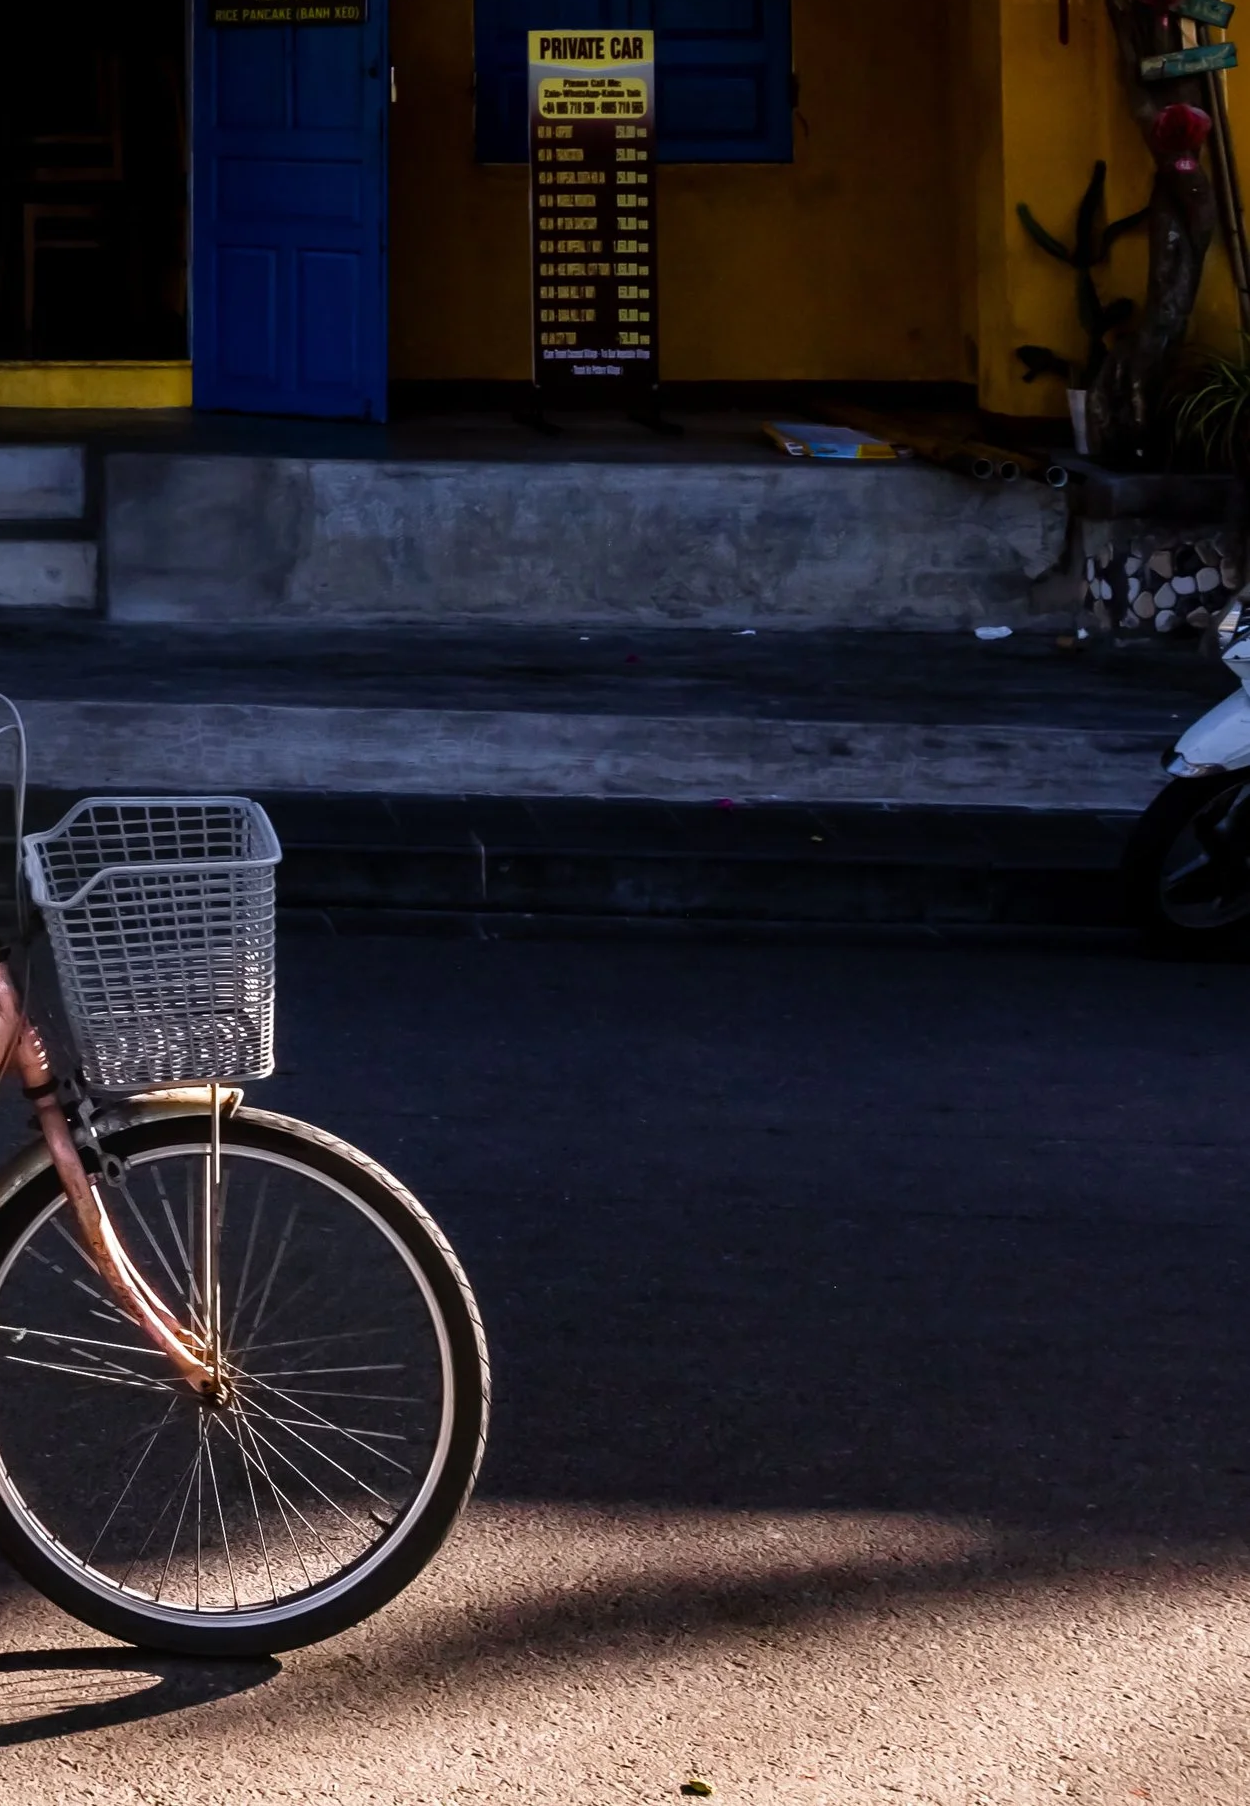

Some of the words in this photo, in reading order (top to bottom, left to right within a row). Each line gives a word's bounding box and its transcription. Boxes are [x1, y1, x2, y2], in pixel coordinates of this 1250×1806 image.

[215, 9, 238, 22] RICE
[242, 8, 291, 22] PANCAKE
[296, 6, 330, 22] (BANH
[540, 37, 604, 59] PRIVATE
[610, 37, 644, 59] CAR
